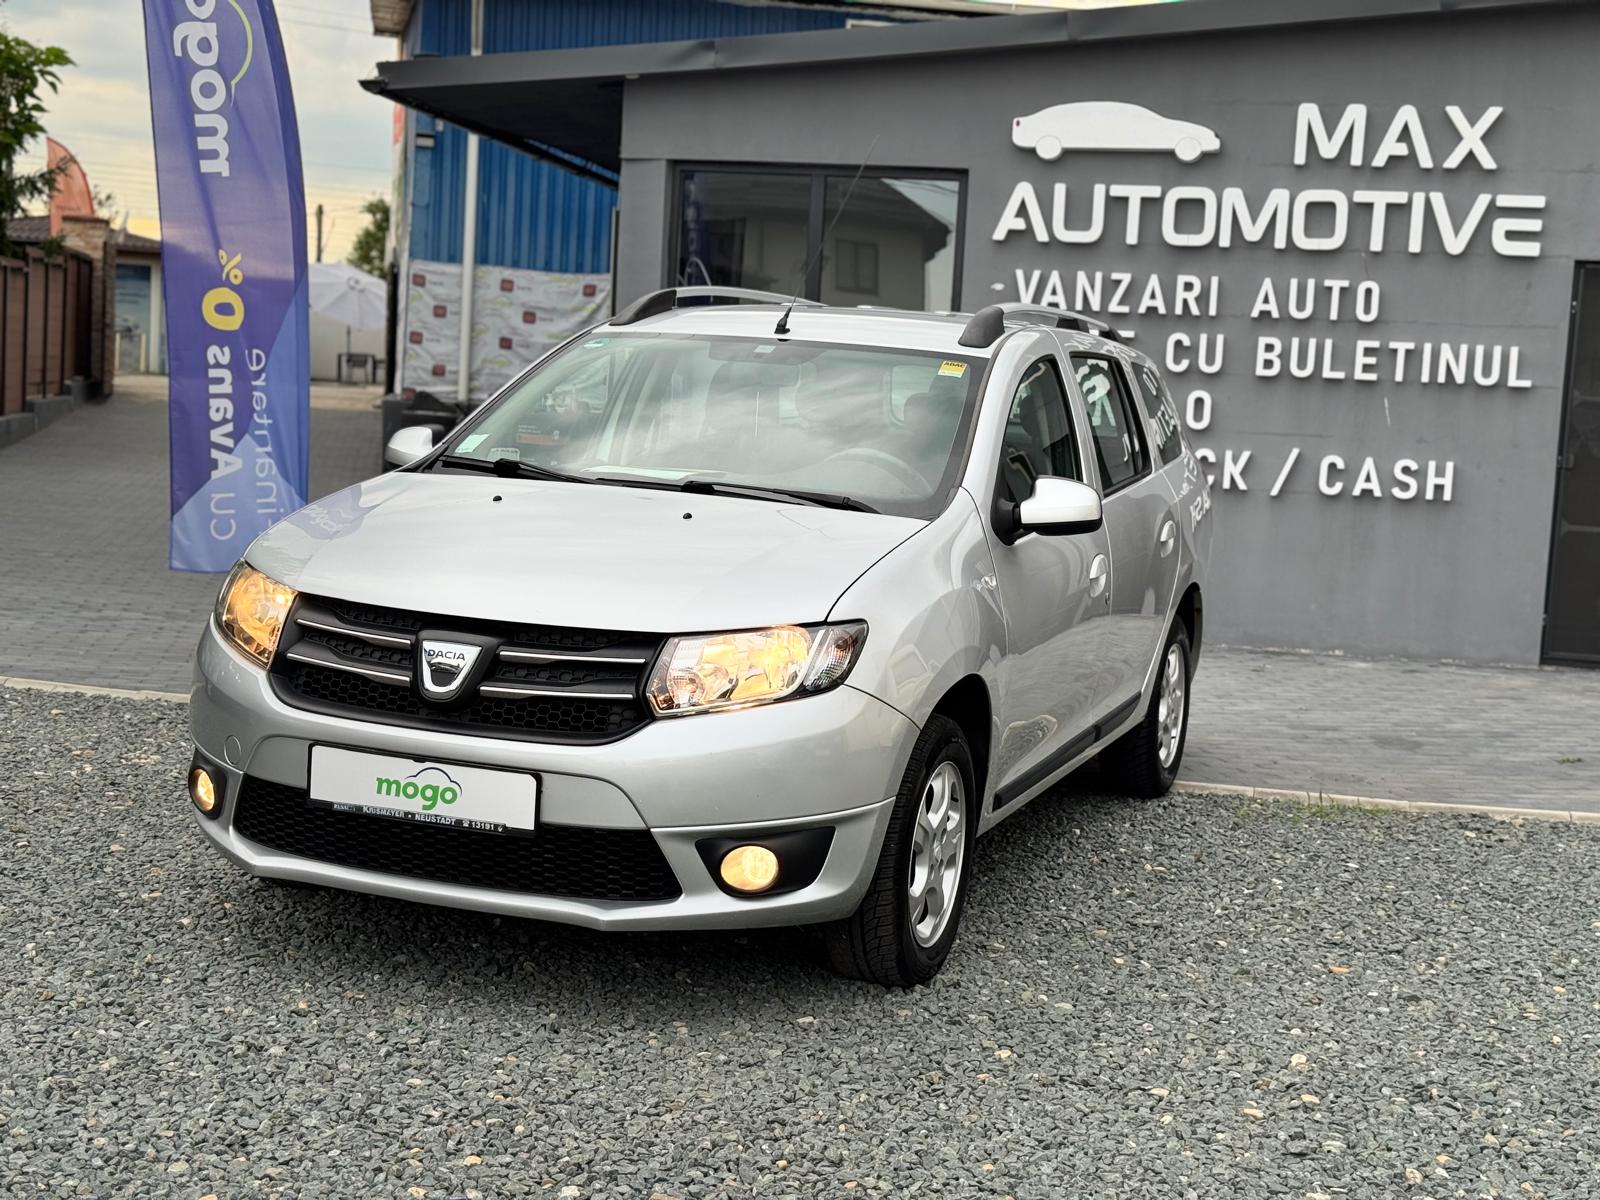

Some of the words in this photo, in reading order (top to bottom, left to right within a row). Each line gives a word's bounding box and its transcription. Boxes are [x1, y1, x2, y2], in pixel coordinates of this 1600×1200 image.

[1293, 102, 1504, 170] MAX
[991, 180, 1547, 257] AUTOMOTIVE
[1014, 268, 1219, 317] VANZARI
[1250, 276, 1381, 323] AUTO
[1165, 331, 1225, 374] CU
[1255, 335, 1533, 389] BULETINUL
[1318, 453, 1455, 501] CASH
[427, 648, 466, 662] DACIA
[376, 776, 459, 811] mogo
[414, 812, 457, 826] NEUSTADT
